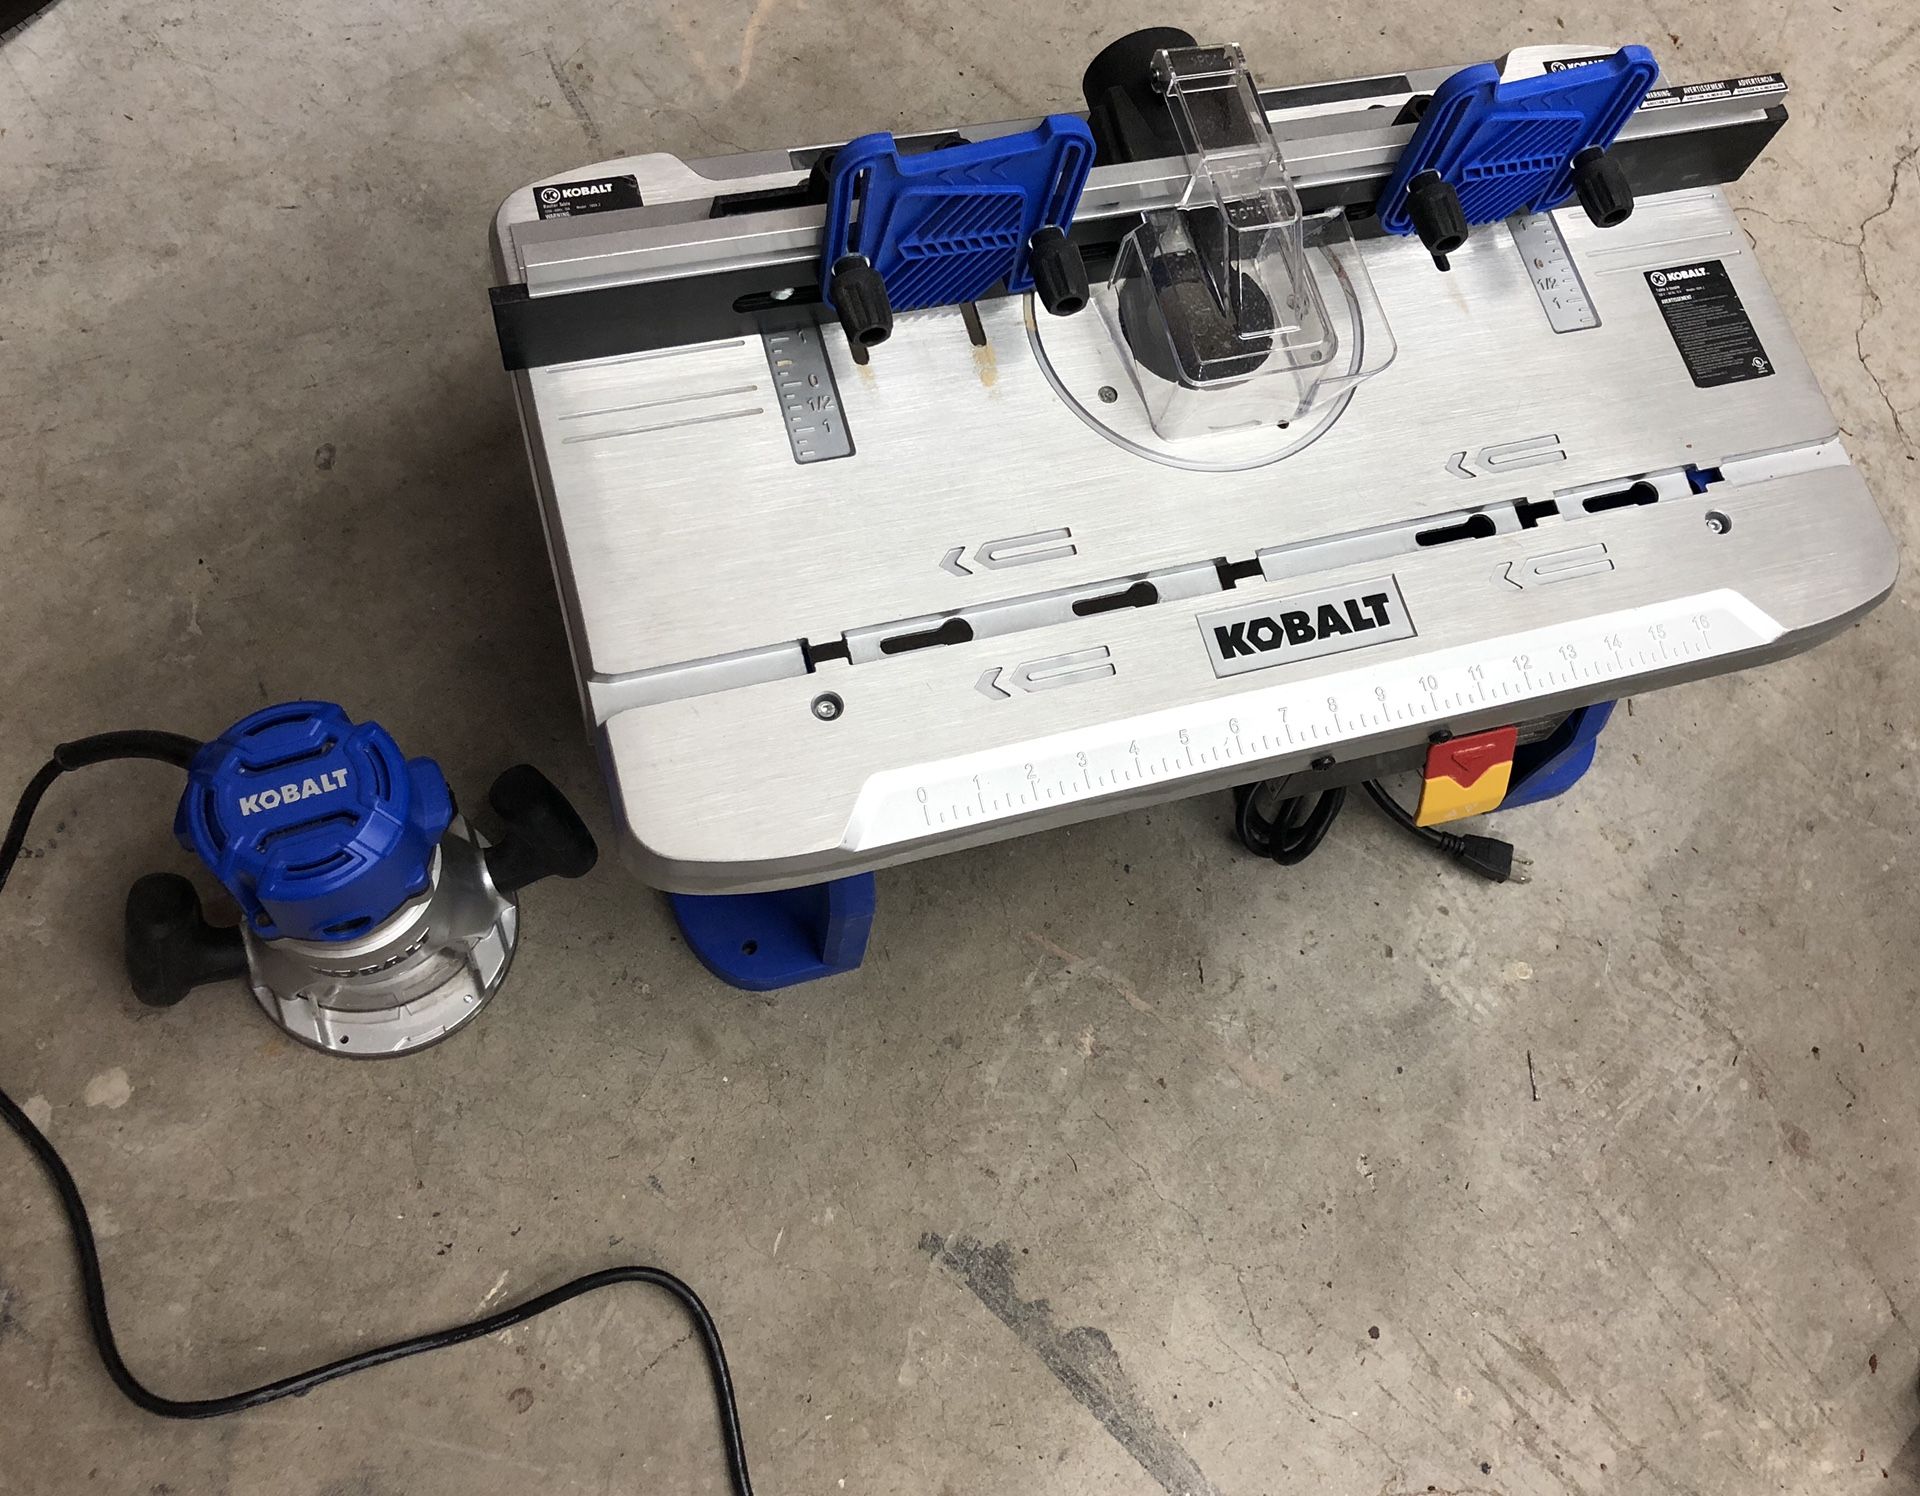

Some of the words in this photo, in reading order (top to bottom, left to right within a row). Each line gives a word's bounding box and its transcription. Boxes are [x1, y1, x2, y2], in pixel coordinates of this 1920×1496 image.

[562, 183, 613, 199] KOBALT
[1666, 267, 1706, 282] KOBALT
[1537, 277, 1560, 291] 1/2
[1552, 297, 1561, 309] 1
[807, 372, 819, 388] 0
[806, 395, 835, 411] 1/2
[822, 418, 831, 433] 1
[1213, 592, 1390, 660] KOBALT
[916, 786, 928, 803] 0
[972, 774, 981, 790] 1
[1024, 763, 1037, 780] 2
[1076, 751, 1088, 767] 3
[1128, 739, 1140, 755] 4
[1178, 728, 1189, 744] 5
[1228, 717, 1240, 733] 6
[1278, 706, 1288, 723] 7
[1327, 696, 1338, 712] 8
[1374, 686, 1386, 702] 9
[1418, 675, 1438, 692] 10
[1467, 664, 1485, 681] 11
[1512, 654, 1533, 672] 12
[1558, 644, 1577, 661] 13
[1603, 633, 1623, 651] 14
[1647, 623, 1667, 641] 15
[1691, 614, 1711, 631] 16
[239, 768, 348, 816] KOBALT
